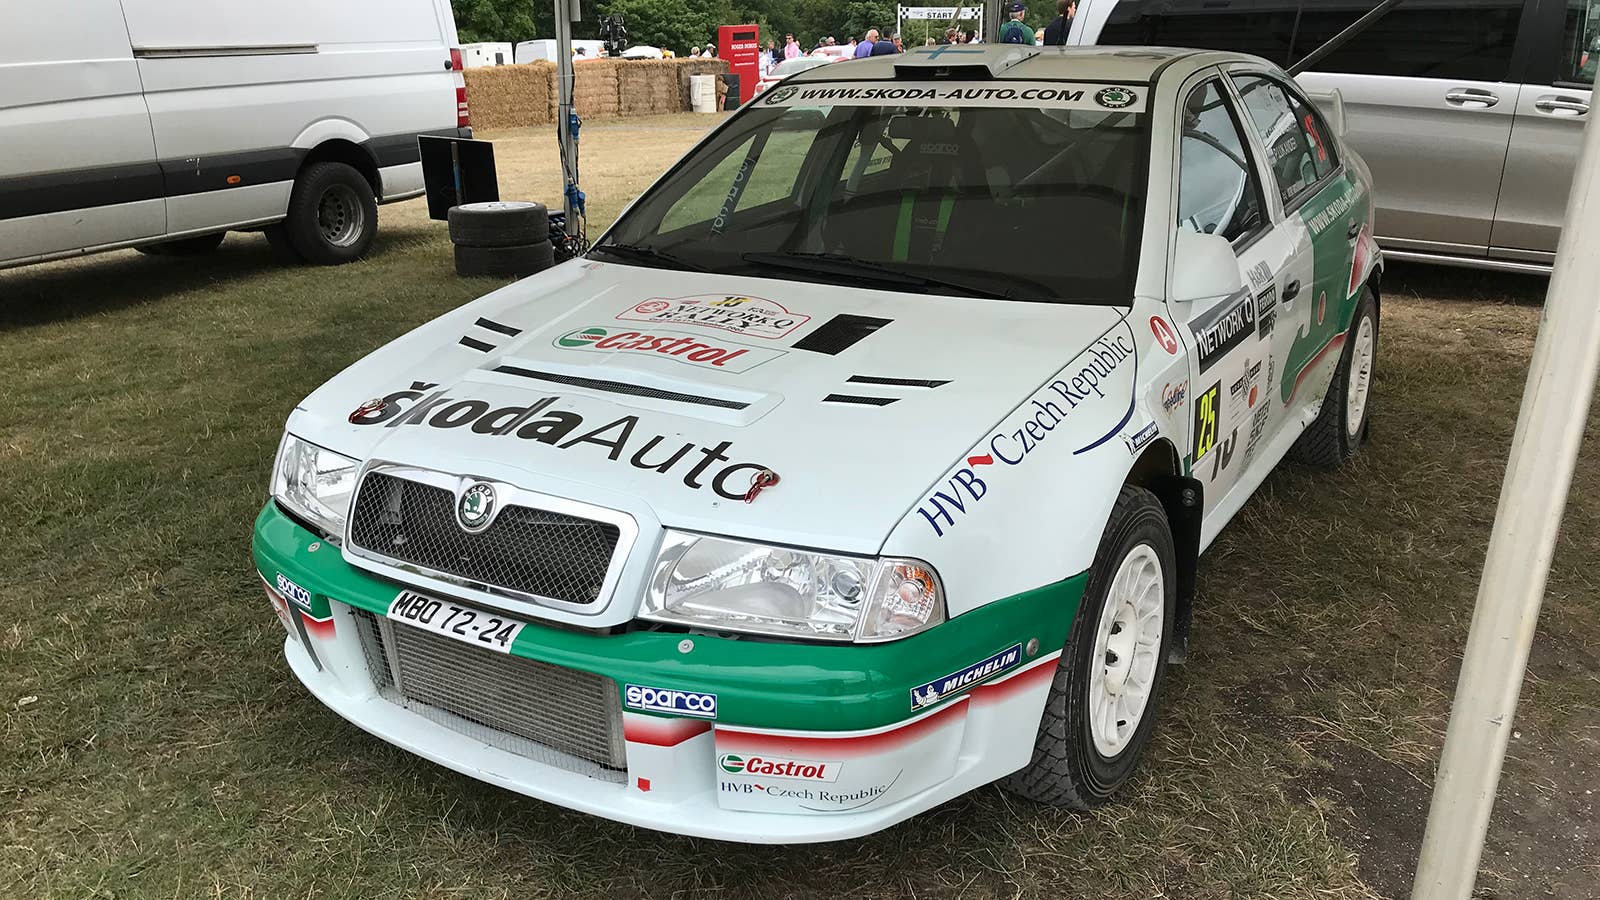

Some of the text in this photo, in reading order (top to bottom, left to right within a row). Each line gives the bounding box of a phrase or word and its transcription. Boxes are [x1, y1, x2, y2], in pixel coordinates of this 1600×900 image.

[800, 88, 1085, 102] WWW.SKODA-AUTO.COM
[774, 319, 794, 329] Q
[1196, 307, 1245, 359] NETWORK
[1245, 296, 1253, 323] Q
[595, 332, 750, 366] Castrol
[917, 335, 1133, 537] HVB Czech Republic
[1196, 387, 1217, 460] 25
[277, 574, 310, 605] sparco
[392, 592, 517, 647] MBO 72-24
[942, 650, 1017, 693] MICHELIN
[627, 686, 714, 711] sparco
[747, 757, 825, 778] Castrol
[721, 782, 886, 804] HVB Czech Republic
